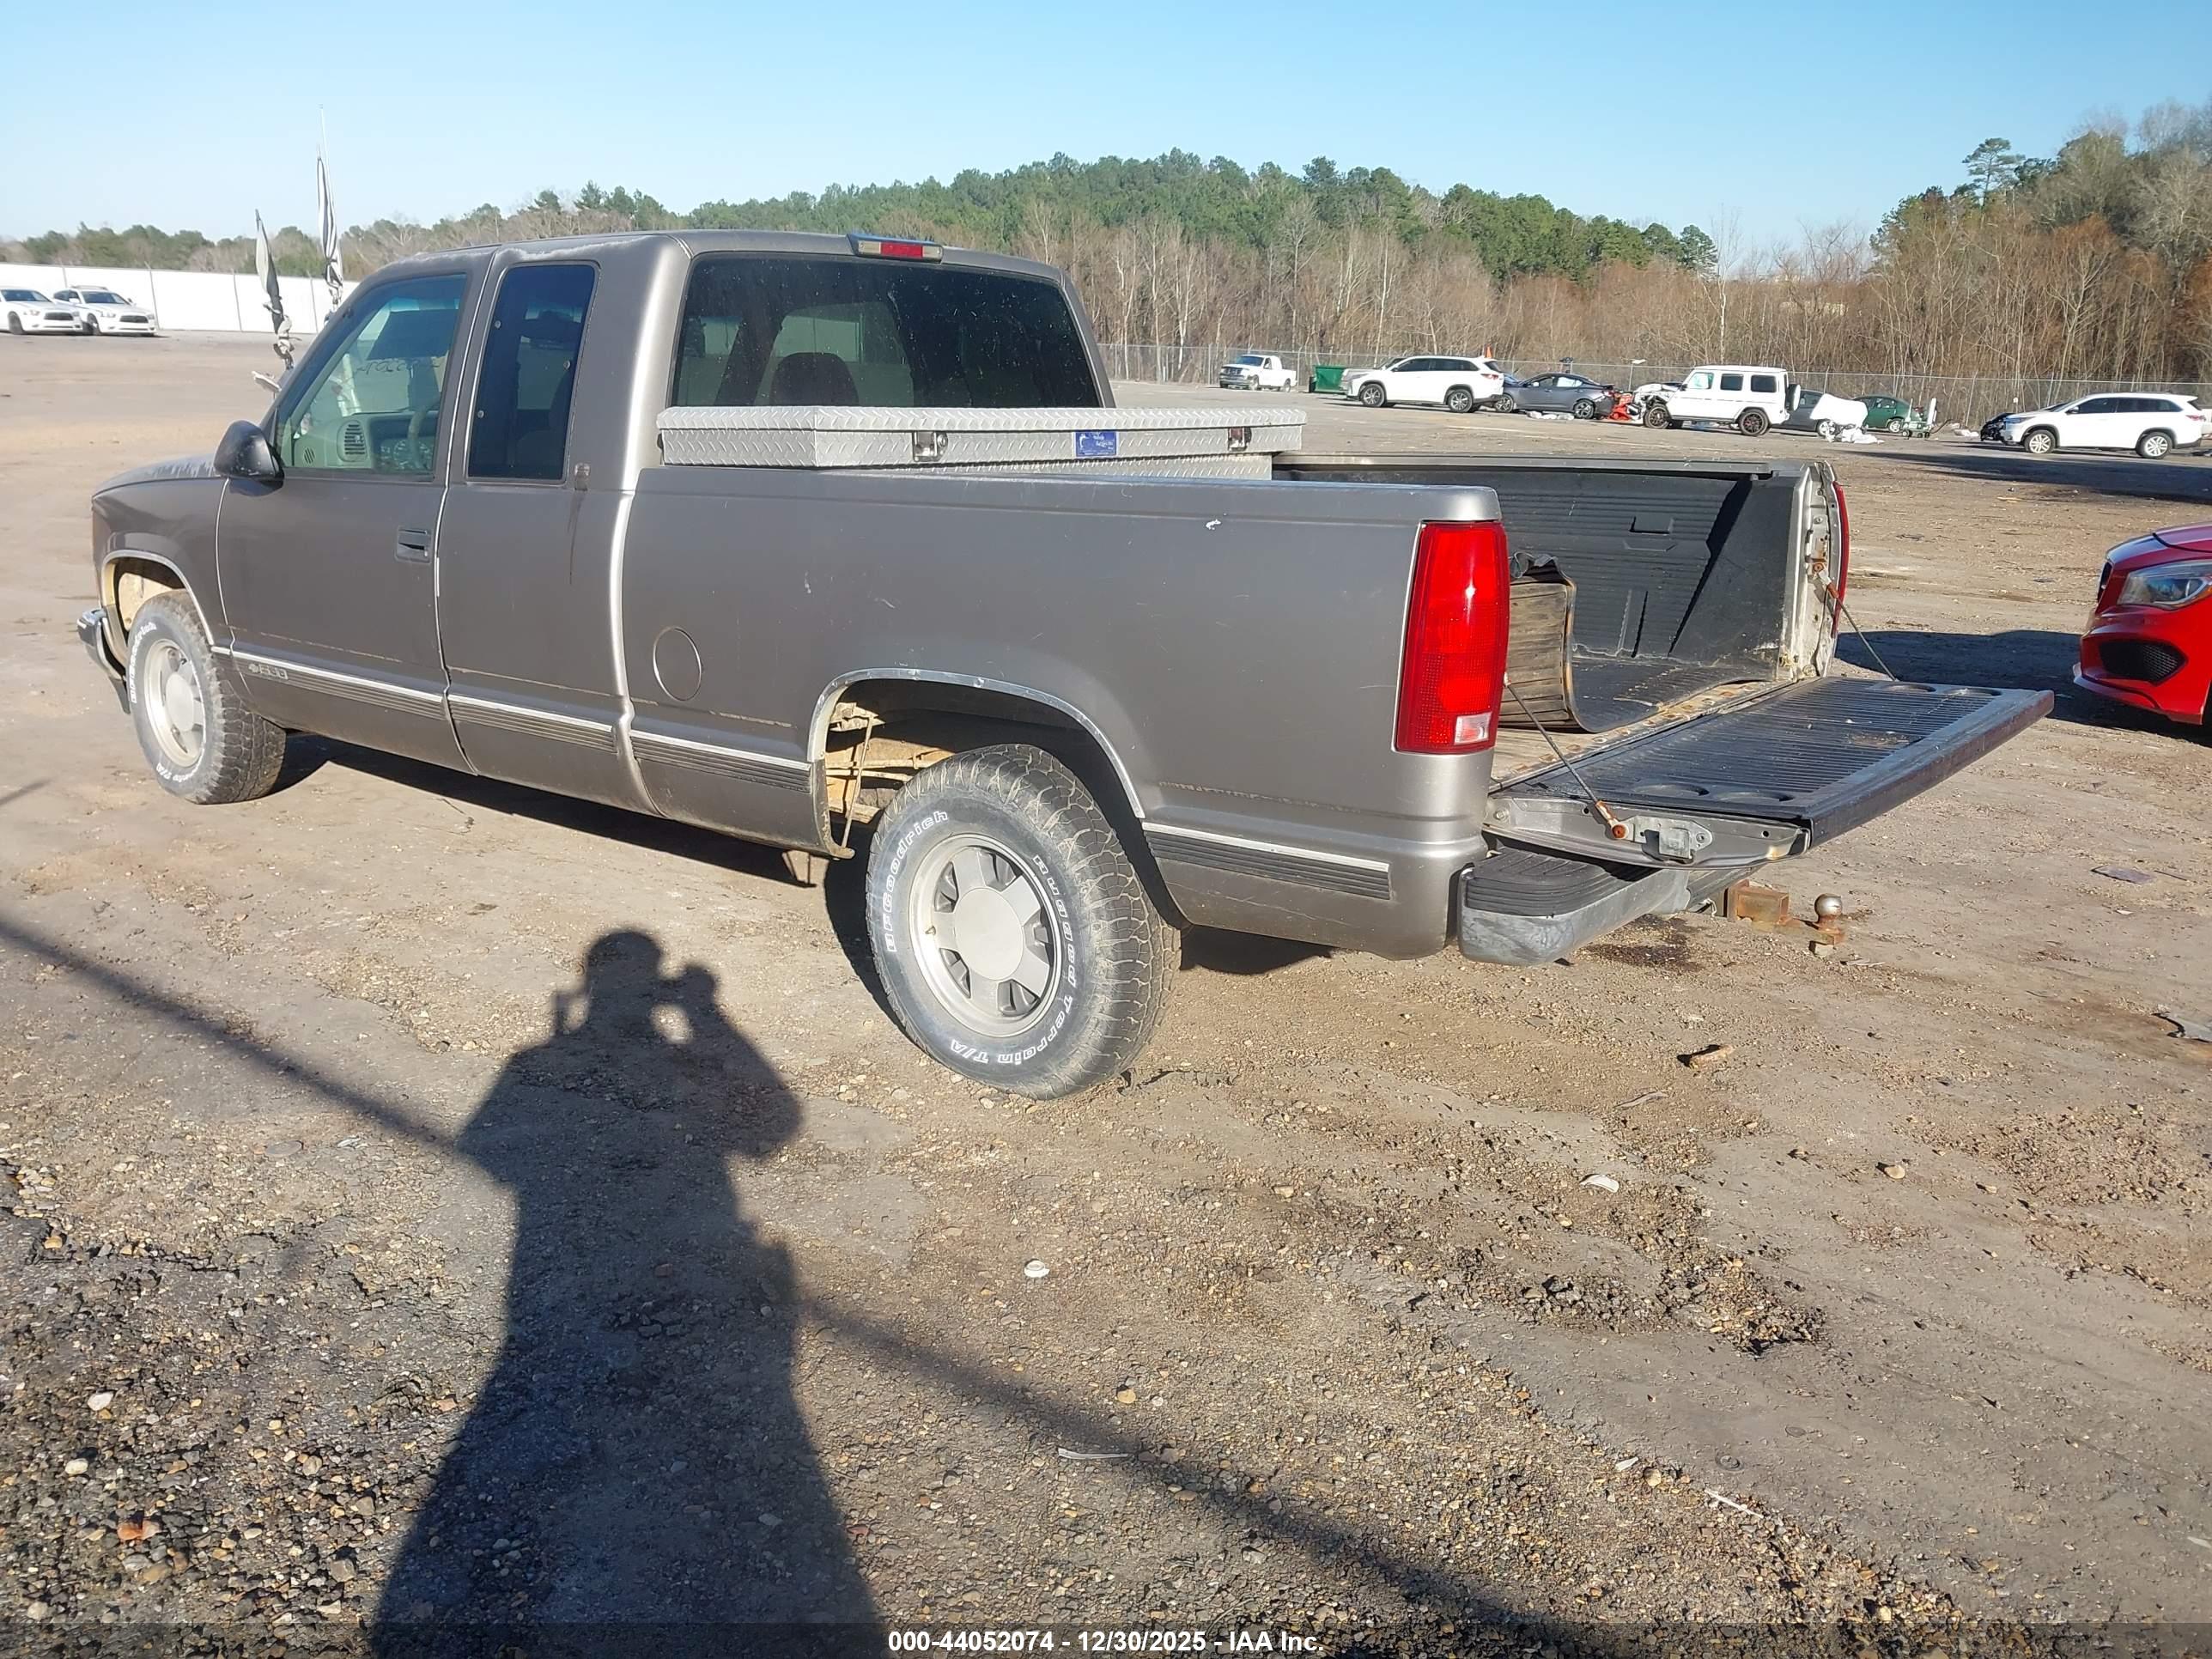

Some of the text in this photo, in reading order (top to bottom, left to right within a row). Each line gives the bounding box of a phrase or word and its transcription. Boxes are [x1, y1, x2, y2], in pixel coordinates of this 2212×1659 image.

[882, 810, 949, 952] BFGoodrich
[950, 854, 1077, 1066] Rugged Terrain T/A
